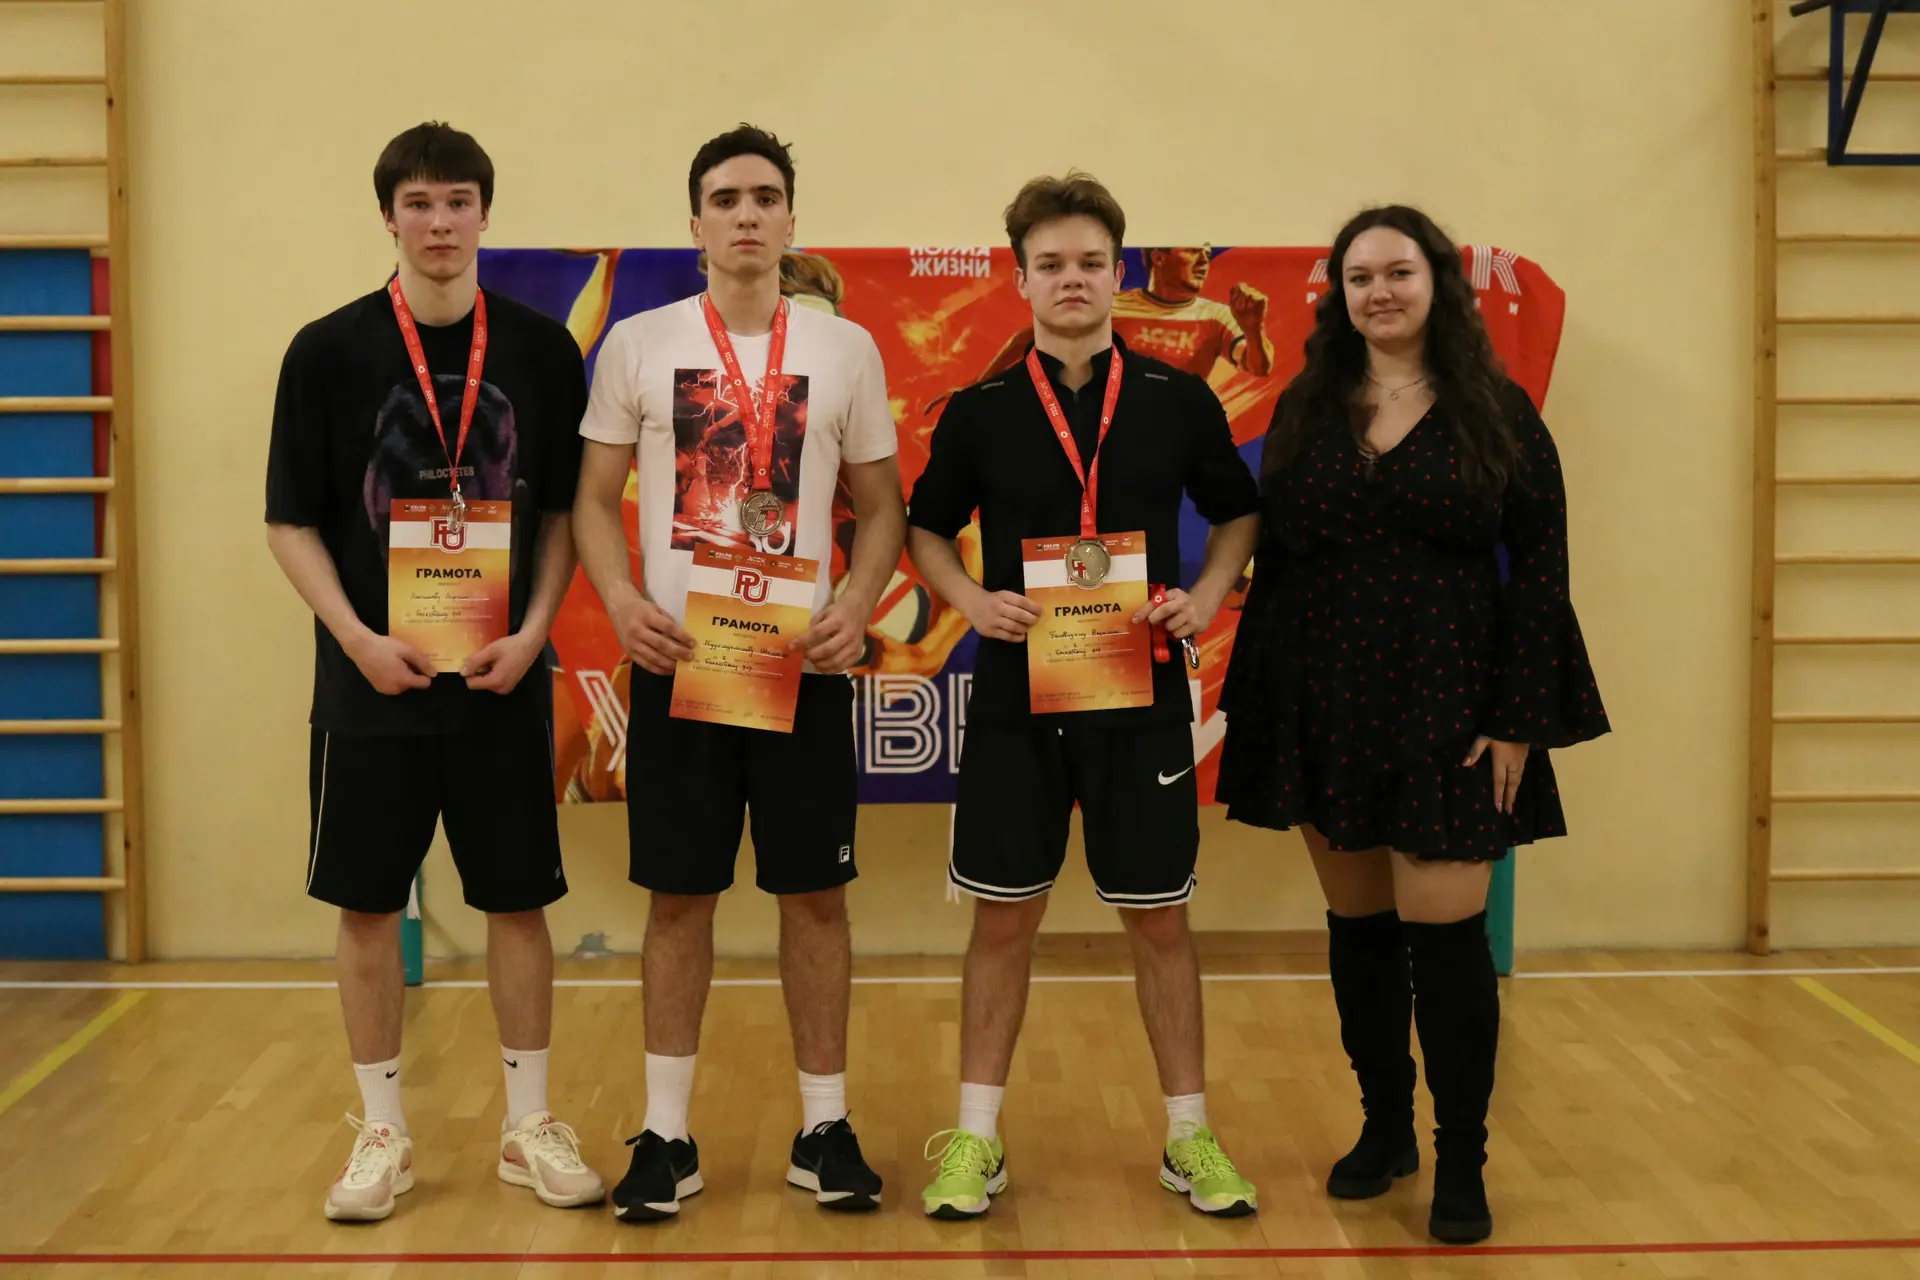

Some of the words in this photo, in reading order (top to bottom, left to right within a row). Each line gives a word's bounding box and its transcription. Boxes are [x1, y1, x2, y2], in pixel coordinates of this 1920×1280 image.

[909, 256, 991, 279] ЖИЗНИ
[415, 567, 482, 579] ГРАМОТА
[1054, 602, 1122, 618] ГРАМОТА
[711, 616, 780, 635] ГРАМОТА
